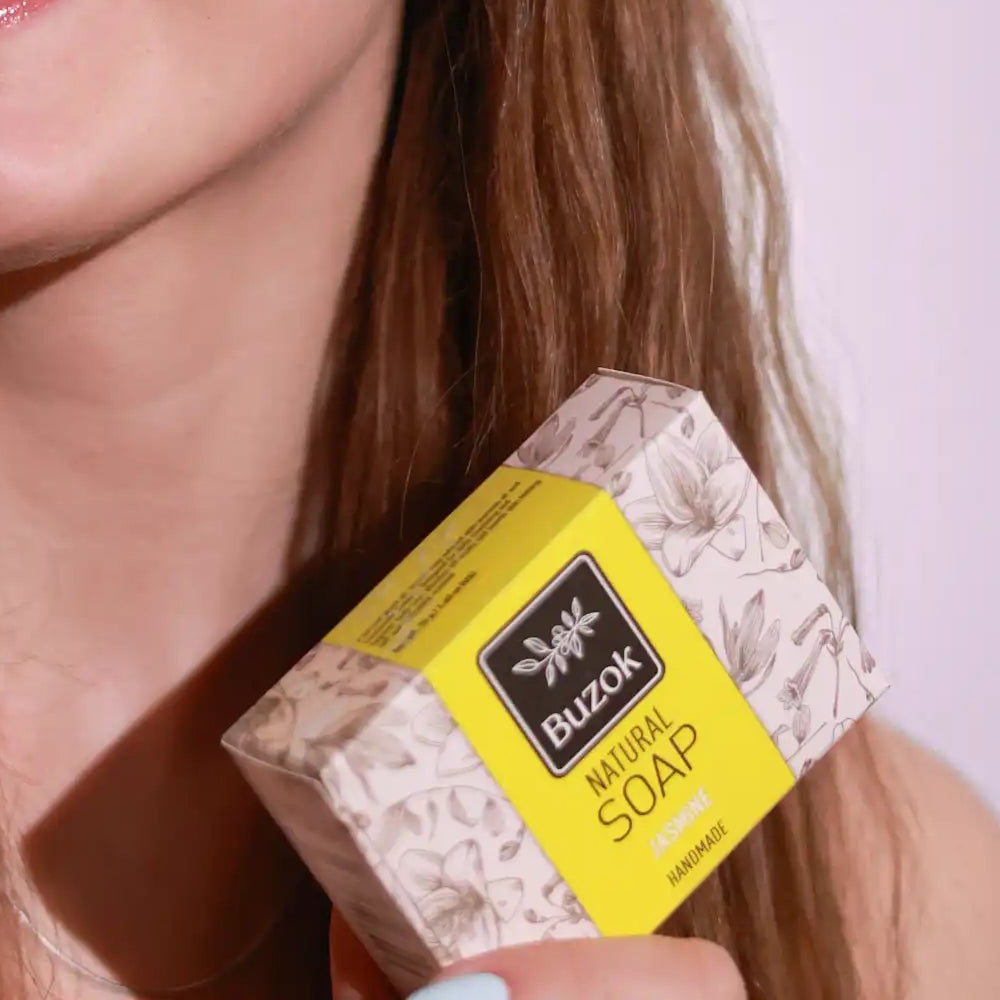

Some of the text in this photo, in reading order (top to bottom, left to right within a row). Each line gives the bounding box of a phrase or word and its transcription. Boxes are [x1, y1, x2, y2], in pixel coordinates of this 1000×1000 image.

[584, 706, 674, 797] NATURAL
[597, 723, 697, 843] SOAP
[650, 785, 712, 860] JASMINE
[666, 818, 729, 888] HANDMADE
